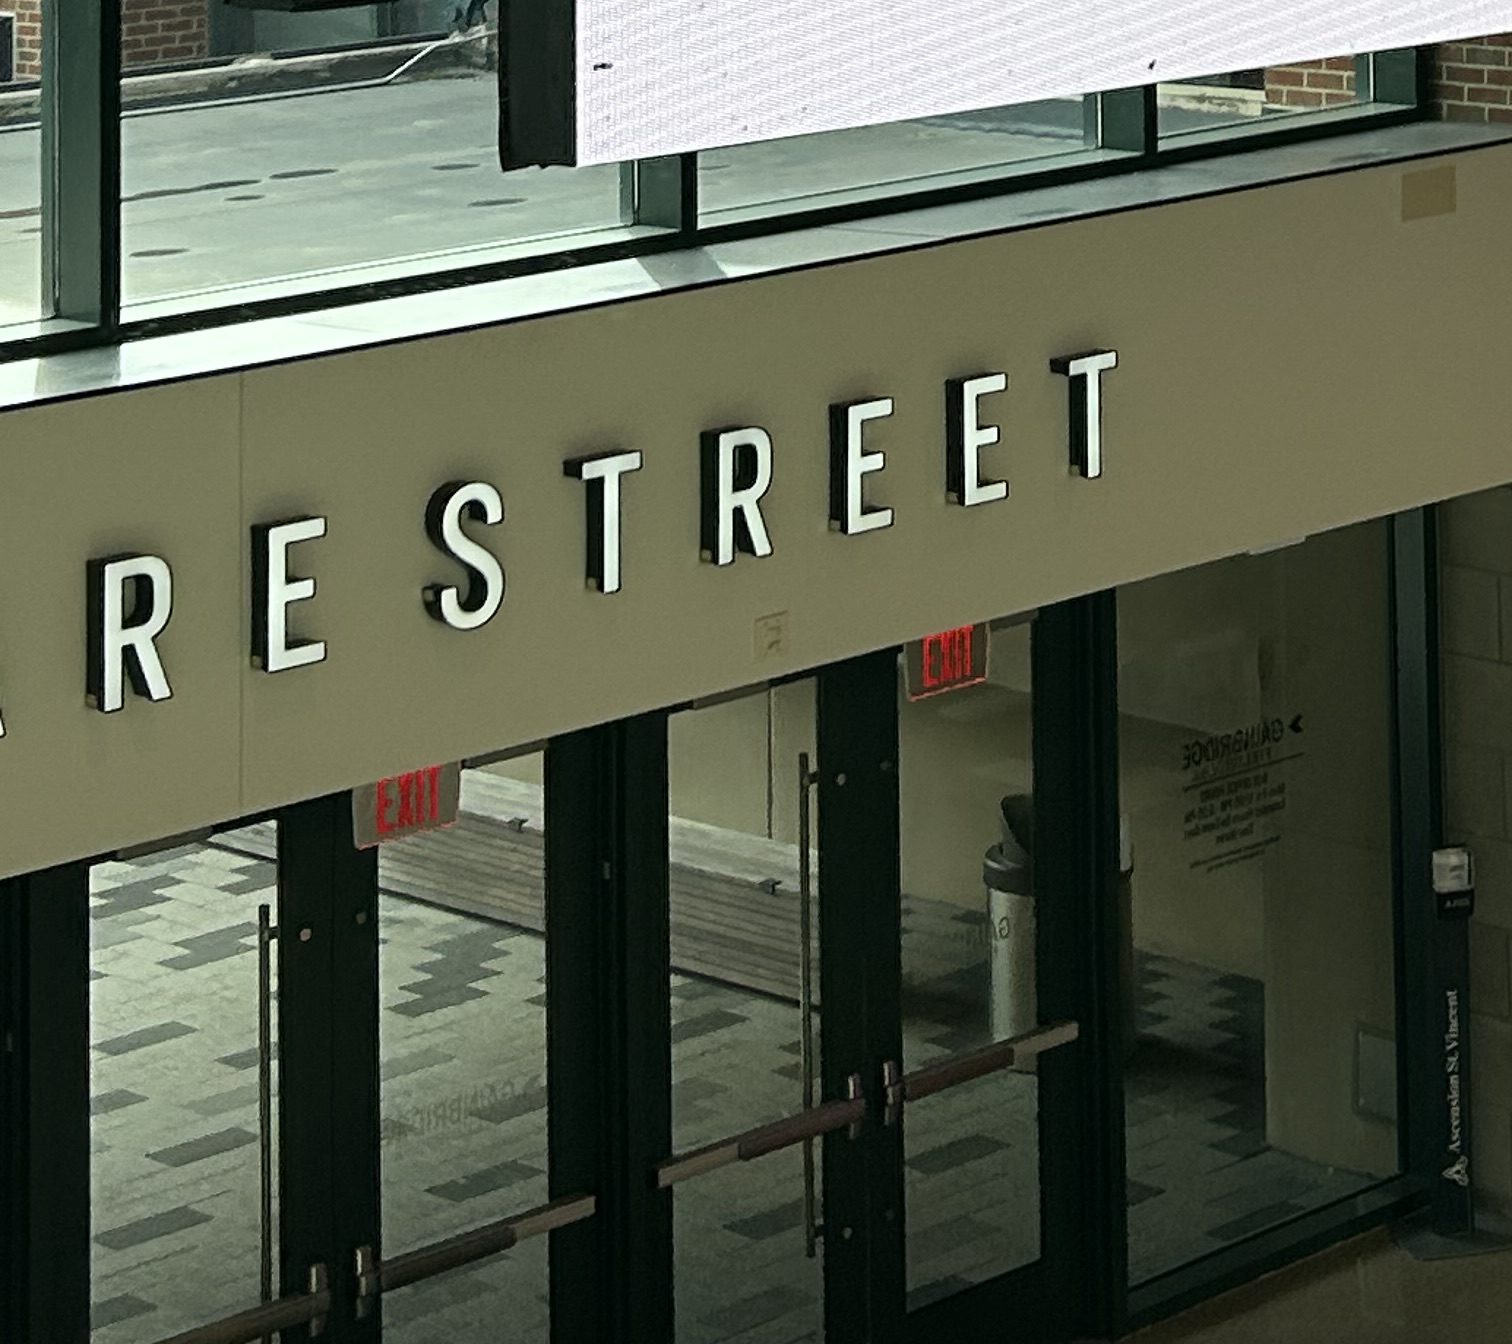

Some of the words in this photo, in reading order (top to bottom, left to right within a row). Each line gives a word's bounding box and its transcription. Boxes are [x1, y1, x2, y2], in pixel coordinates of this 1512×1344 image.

[0, 516, 328, 736] RE
[423, 350, 1118, 631] STREET
[923, 623, 974, 688] EXIT
[376, 764, 444, 834] EXIT
